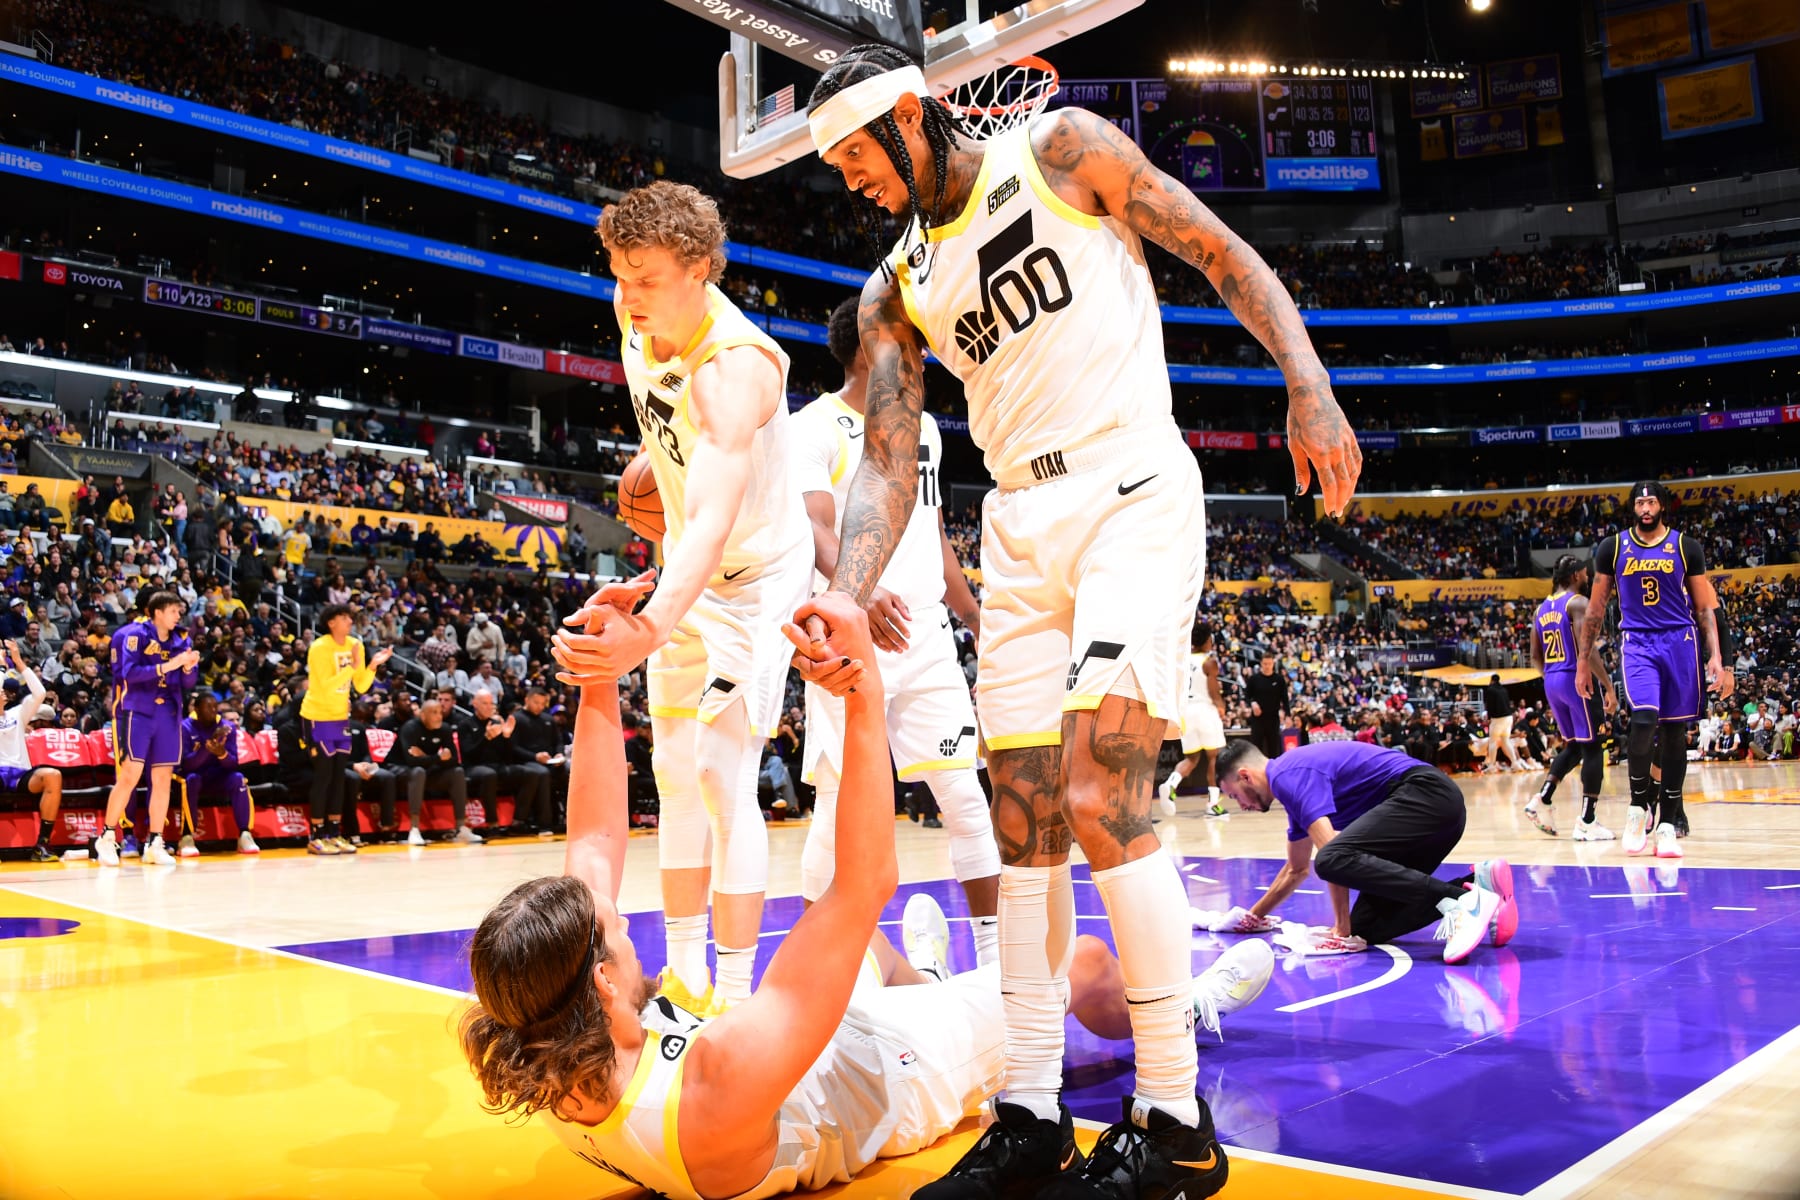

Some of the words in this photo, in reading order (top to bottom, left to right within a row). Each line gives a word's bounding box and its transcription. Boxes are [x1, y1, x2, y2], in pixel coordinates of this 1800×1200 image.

[694, 0, 744, 20] Ma
[741, 14, 809, 48] Asset
[28, 70, 76, 88] SOLUTIONS
[1491, 78, 1556, 96] CHAMPIONS
[1072, 85, 1109, 102] STATS
[1351, 85, 1368, 100] 110
[1415, 88, 1478, 106] CHAMPIONS
[1353, 106, 1370, 121] 123
[1307, 130, 1336, 148] 3:06
[1457, 129, 1523, 147] CHAMPIONS
[96, 86, 174, 114] mobilitie
[190, 111, 225, 127] WIRELESS
[226, 119, 270, 137] COVERAGE
[270, 131, 309, 147] SOLUTIONS
[325, 144, 391, 168] mobilitie
[518, 193, 574, 214] mobilitie
[508, 160, 554, 181] Spectrum
[1278, 165, 1370, 180] mobilitie
[990, 192, 997, 213] 5
[999, 183, 1018, 205] FIGHT
[61, 168, 99, 184] WIRELESS
[101, 176, 149, 194] COVERAGE
[150, 187, 193, 204] SOLUTIONS
[211, 200, 283, 224] mobilitie
[424, 247, 485, 268] mobilitie
[71, 271, 124, 291] TOYOTA
[990, 246, 1073, 335] 00
[156, 286, 179, 302] 110
[190, 291, 211, 308] 123
[224, 297, 255, 316] 3:06
[1564, 301, 1616, 313] mobilitie
[1726, 281, 1781, 297] mobilitie
[266, 305, 295, 319] FOULS
[309, 312, 317, 325] 5
[338, 319, 346, 331] 5
[1410, 312, 1459, 321] mobilitie
[368, 325, 413, 341] AMERICAN
[414, 332, 453, 348] EXPRESS
[467, 342, 495, 357] UCLA
[502, 348, 540, 365] Health
[1486, 366, 1537, 377] mobilitie
[1643, 354, 1696, 367] mobilitie
[1733, 348, 1766, 358] COVERAGE
[569, 359, 613, 379] Coca-Cola
[1336, 372, 1384, 381] mobilitie
[1731, 412, 1754, 421] VICTORY
[1755, 409, 1775, 418] TASTES
[1554, 428, 1578, 438] UCLA
[1583, 424, 1618, 438] Health
[1643, 420, 1691, 431] crypto.com
[1207, 433, 1244, 448] Coca-Cola
[1479, 429, 1535, 444] Spectrum
[1031, 449, 1068, 480] UTAH
[919, 465, 937, 507] 11
[1450, 499, 1498, 513] LOS
[1622, 558, 1674, 577] LAKERS
[1641, 576, 1661, 607] 3
[1542, 628, 1566, 664] 21
[1407, 653, 1436, 663] ULTRA
[46, 729, 80, 743] BIO
[63, 811, 97, 825] BIO
